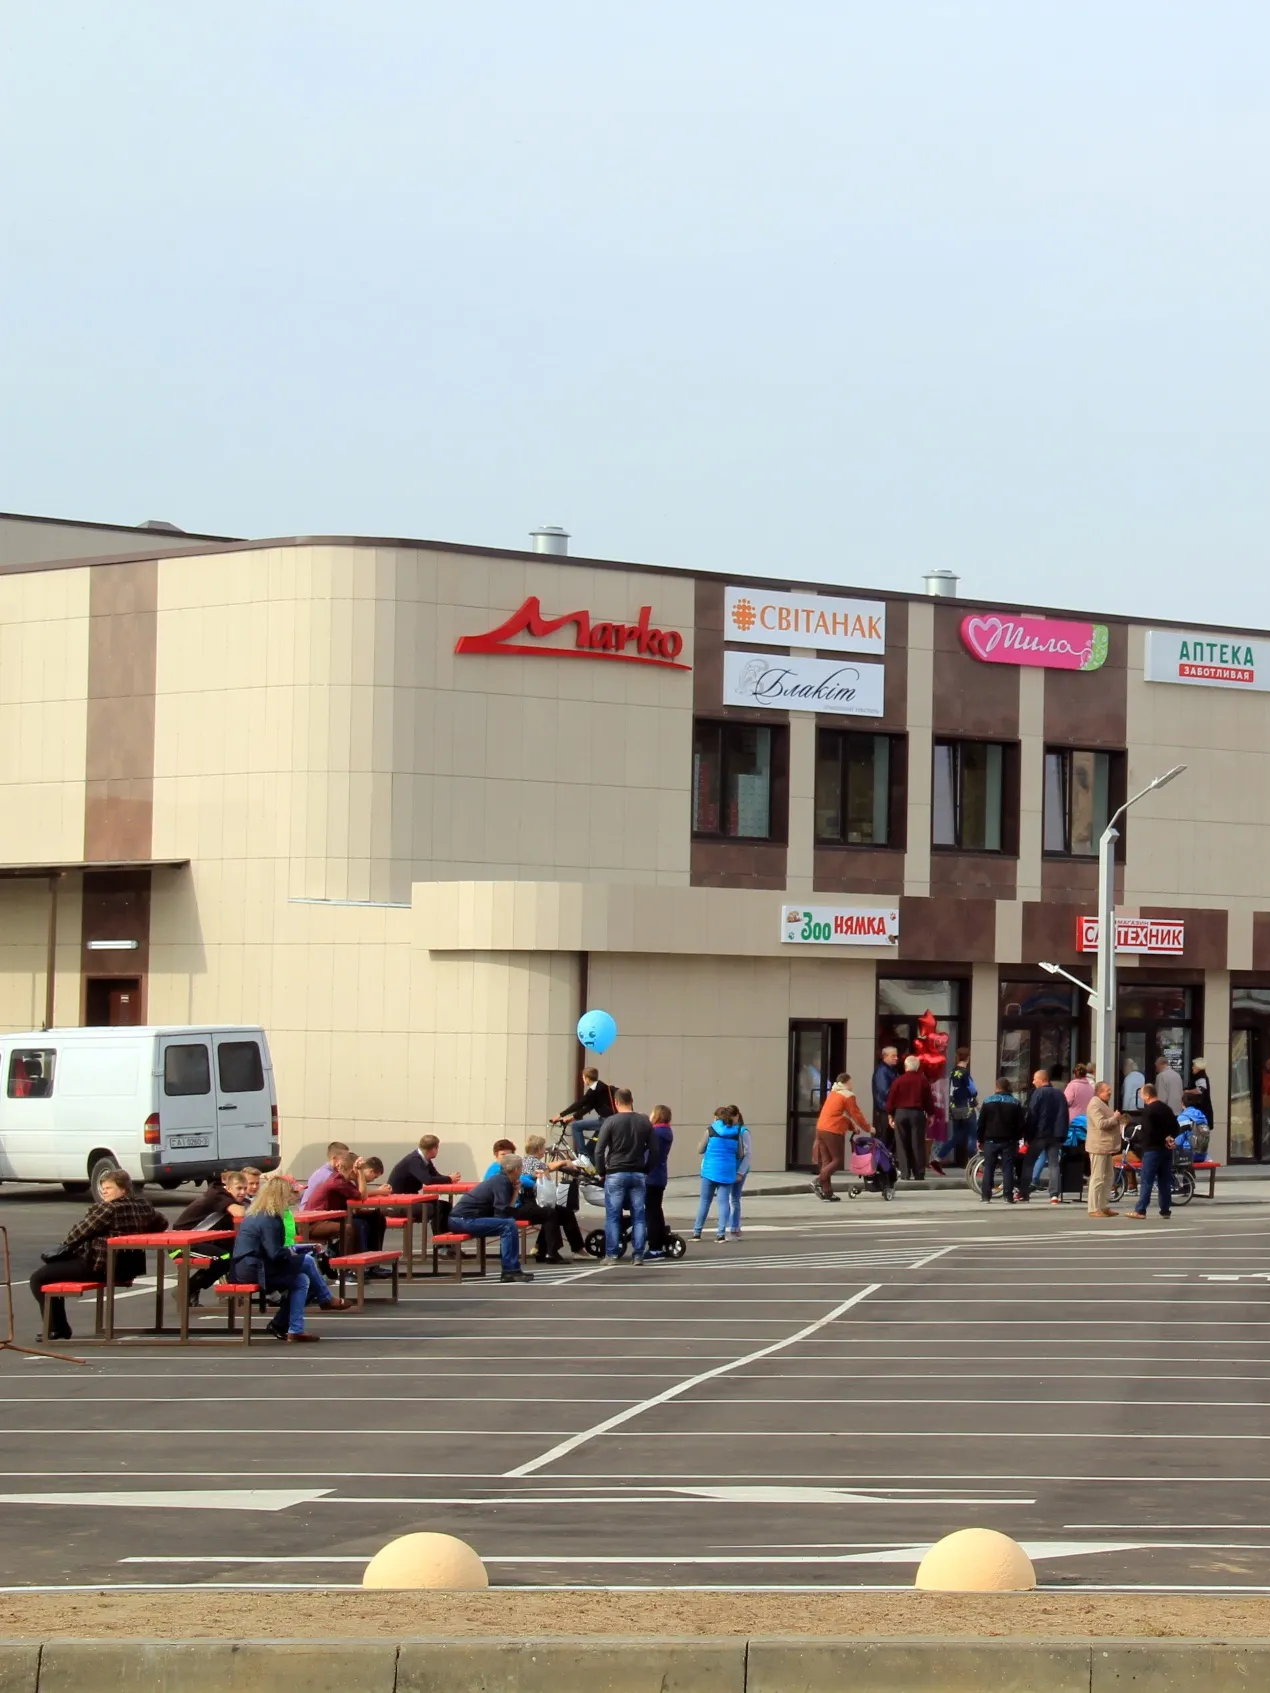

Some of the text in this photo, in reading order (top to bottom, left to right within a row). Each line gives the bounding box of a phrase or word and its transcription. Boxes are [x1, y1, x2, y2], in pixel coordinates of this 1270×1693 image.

[454, 596, 692, 671] Marko
[760, 605, 882, 640] СВІТАНАК
[985, 622, 1080, 655] Мила
[1179, 640, 1254, 667] АПТЕКА
[752, 667, 860, 705] Блакіт
[1183, 665, 1250, 681] ЗАБОТЛИВАЯ
[801, 911, 832, 941] Зоо
[834, 915, 887, 936] НЯМКА
[1085, 926, 1183, 947] СТЕХНИК
